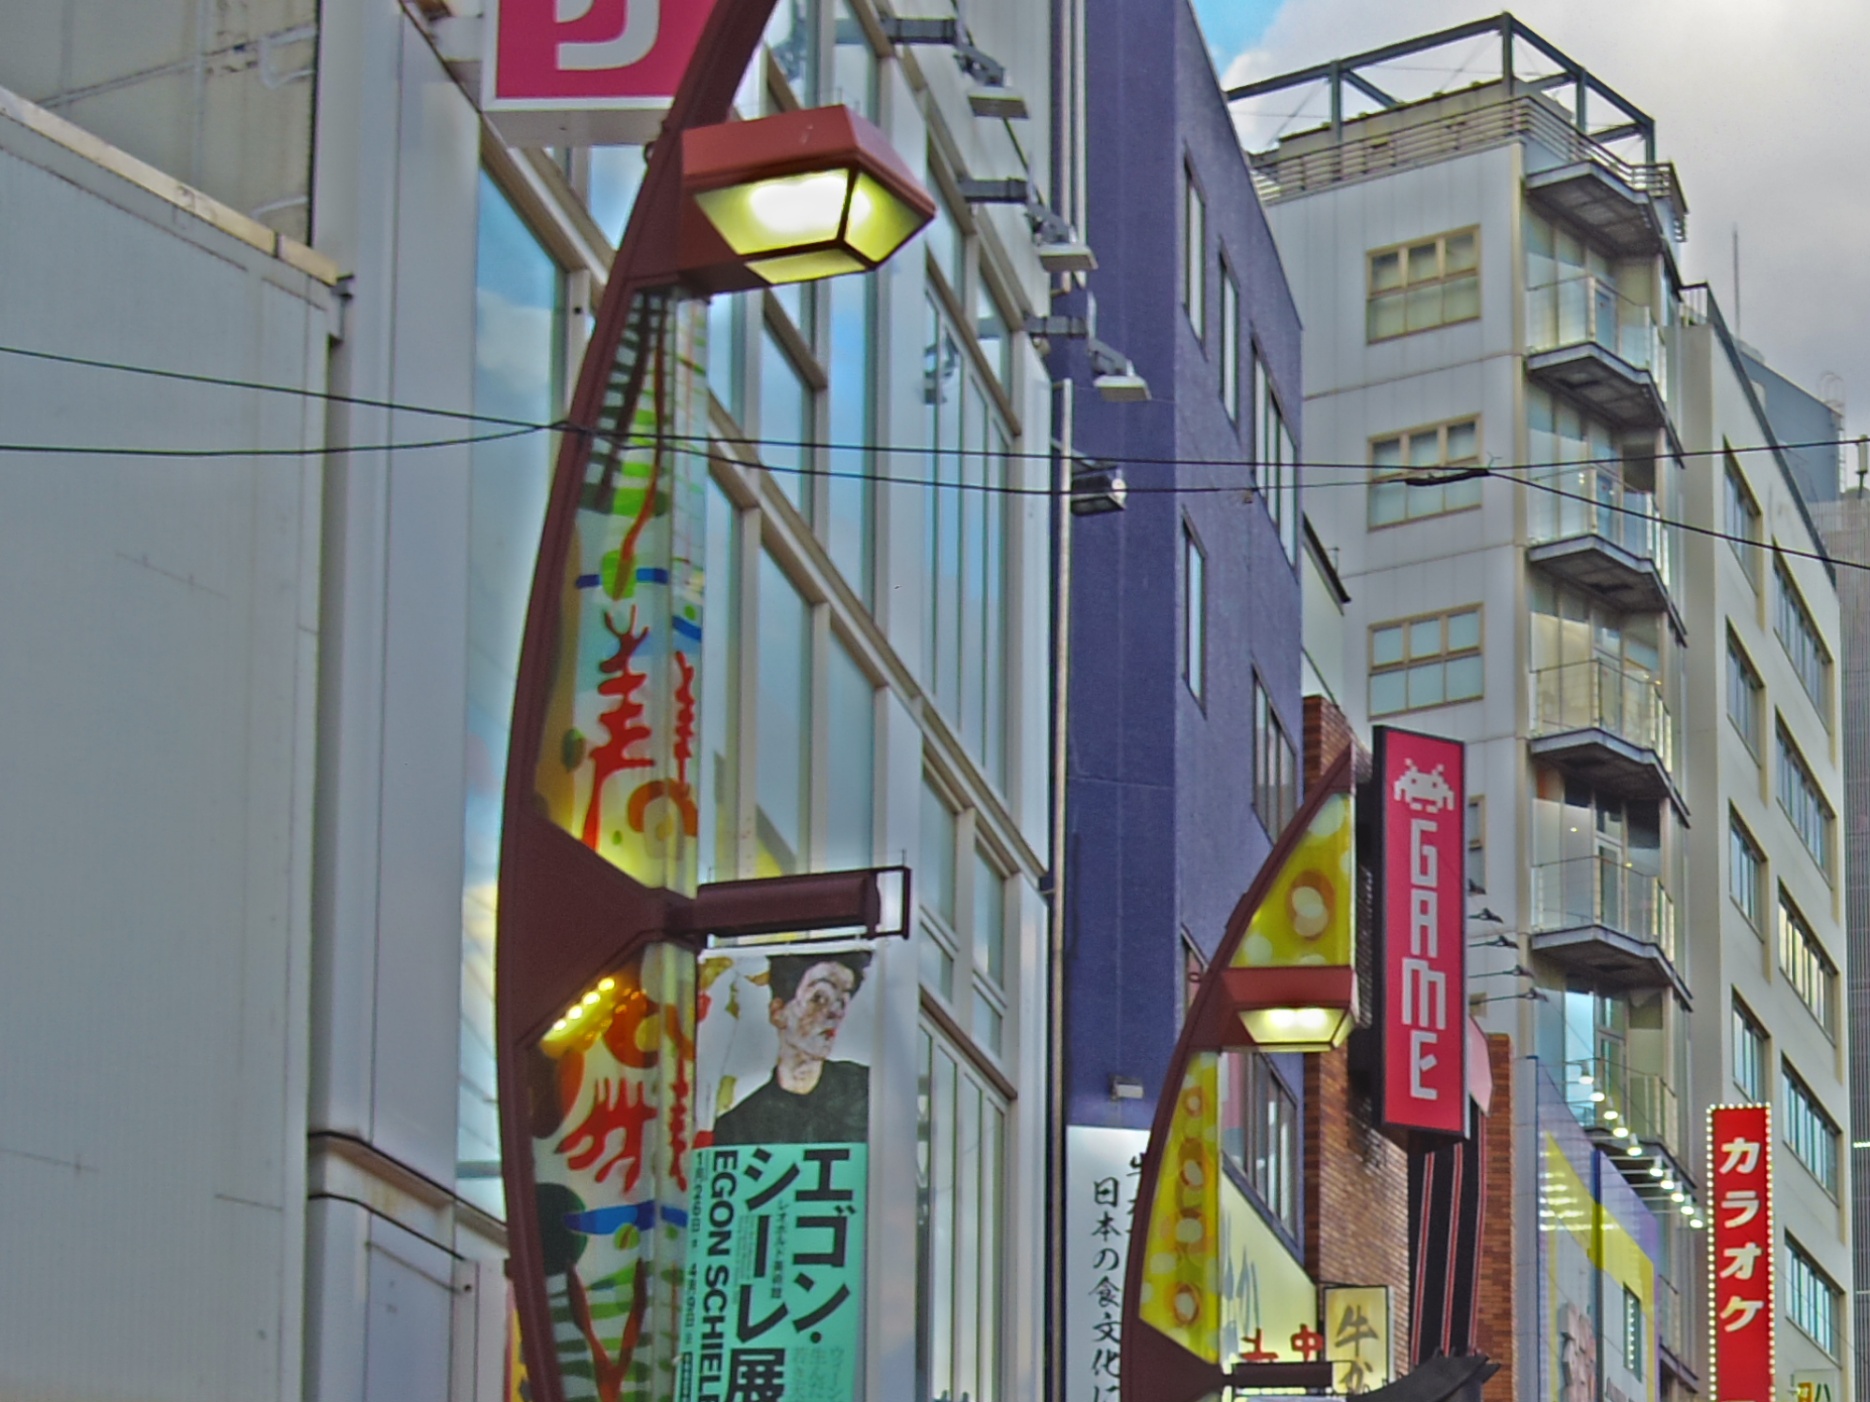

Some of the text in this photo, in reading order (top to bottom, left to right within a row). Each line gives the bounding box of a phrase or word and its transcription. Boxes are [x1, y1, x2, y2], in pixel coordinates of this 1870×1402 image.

[1401, 818, 1447, 1101] GAME
[706, 1150, 739, 1257] EGON
[1718, 1136, 1765, 1333] カラオケ
